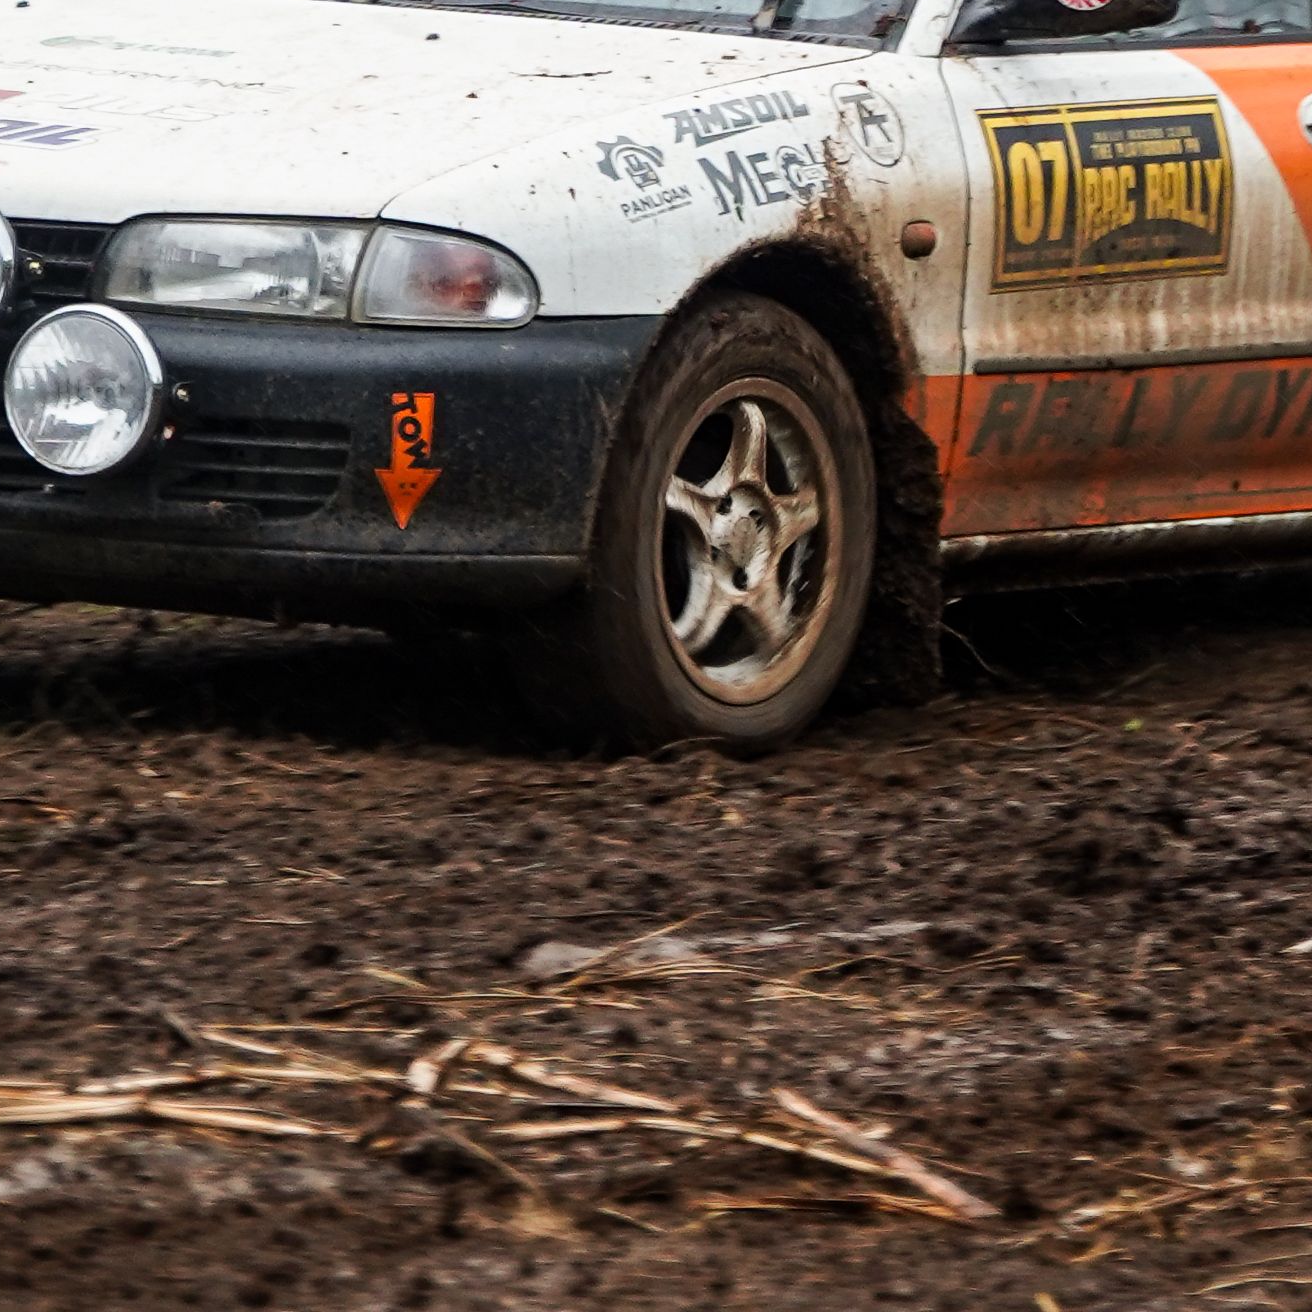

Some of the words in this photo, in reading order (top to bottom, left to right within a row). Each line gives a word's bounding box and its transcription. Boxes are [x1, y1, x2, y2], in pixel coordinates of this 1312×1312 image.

[662, 90, 810, 146] AMSOIL
[1006, 140, 1069, 245] 07
[1144, 158, 1224, 236] RALLY
[964, 373, 1208, 457] RALLY
